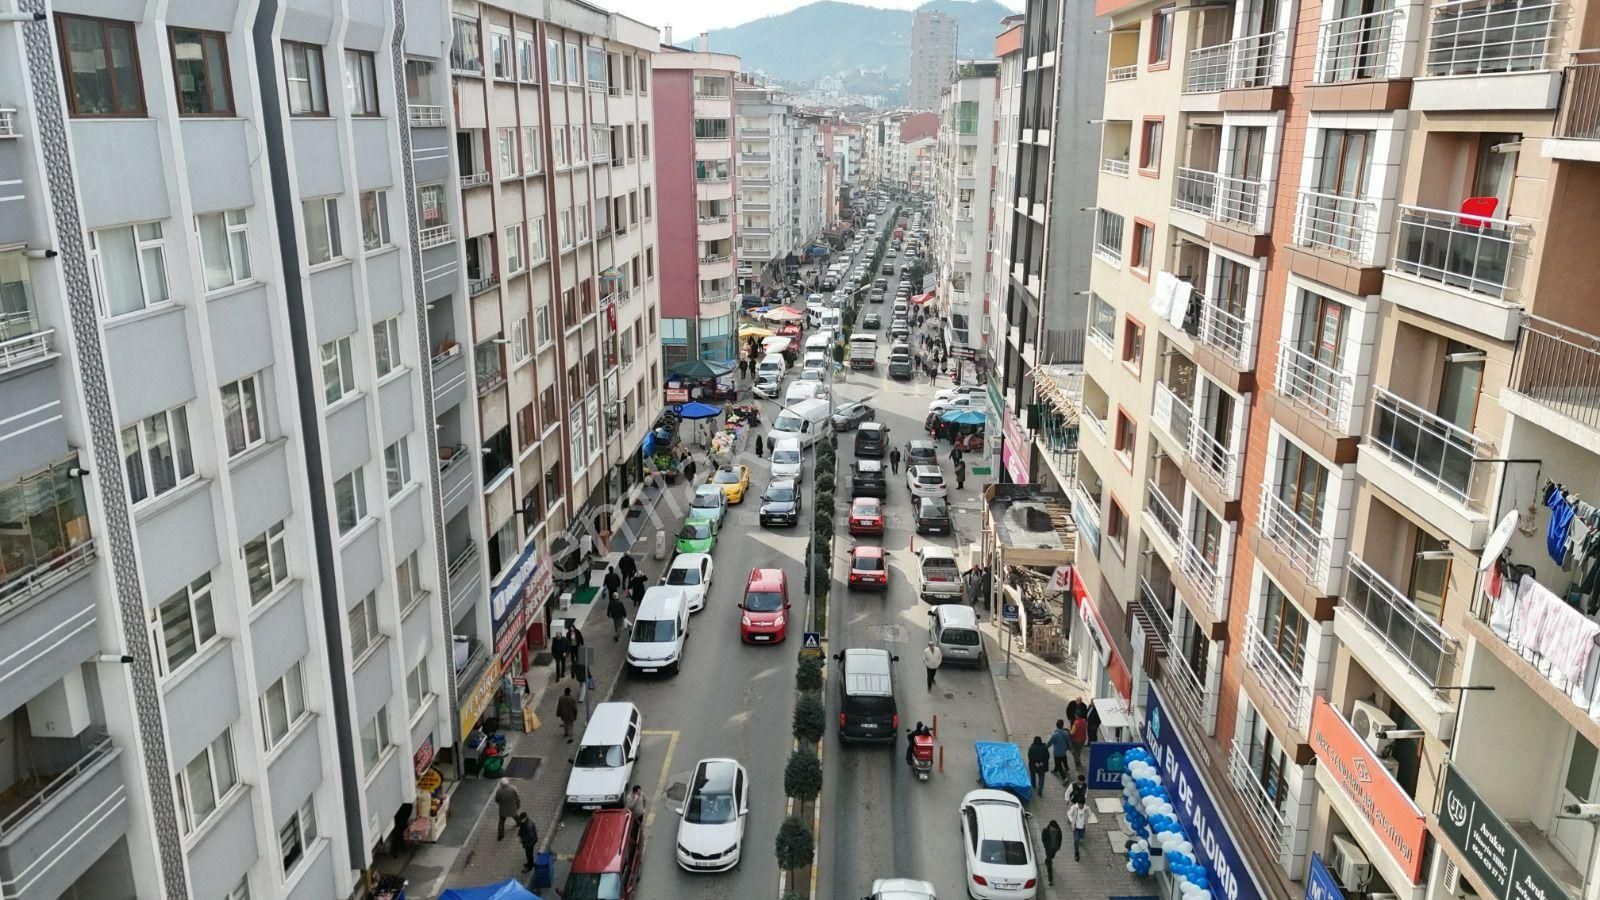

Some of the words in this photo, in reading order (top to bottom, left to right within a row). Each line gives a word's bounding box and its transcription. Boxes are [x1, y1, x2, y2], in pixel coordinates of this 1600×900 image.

[1095, 767, 1121, 783] fuz
[1165, 745, 1179, 783] EV
[1178, 771, 1193, 817] DE
[1192, 804, 1239, 900] ALDIRIR
[1480, 822, 1505, 857] Avukat
